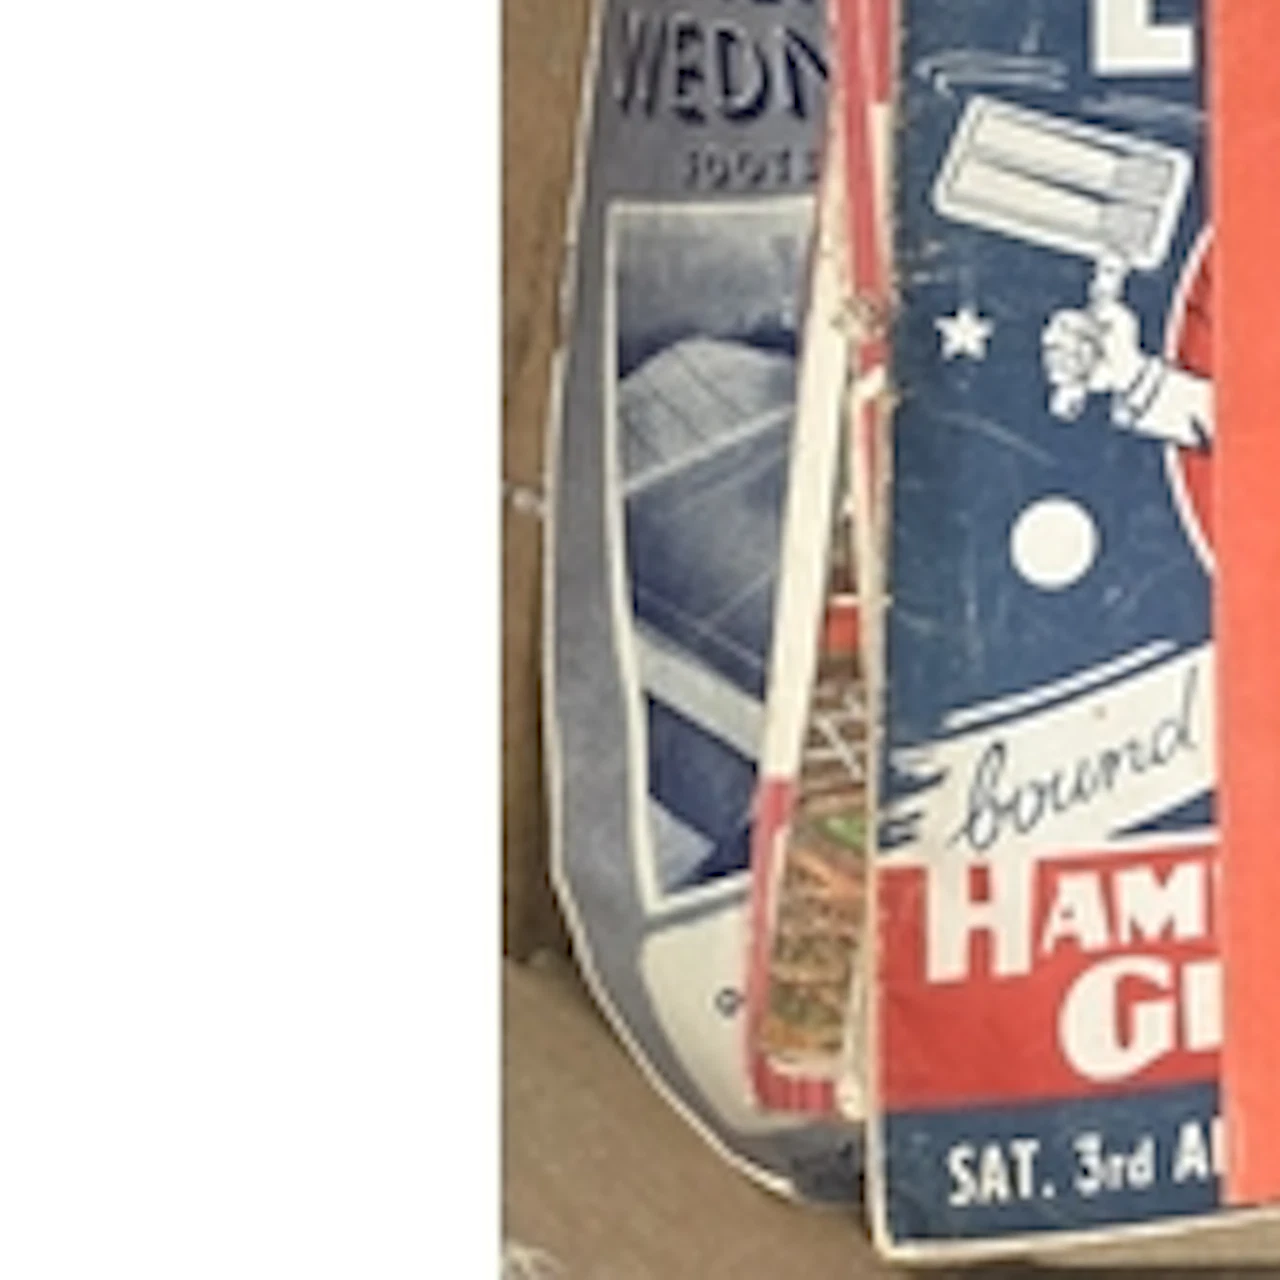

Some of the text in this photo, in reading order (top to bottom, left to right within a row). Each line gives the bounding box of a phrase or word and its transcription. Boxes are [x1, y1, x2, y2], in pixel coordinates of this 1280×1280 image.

[924, 848, 1222, 985] HAM
[947, 1142, 1054, 1208] SAT.
[1074, 1130, 1155, 1191] 3rd
